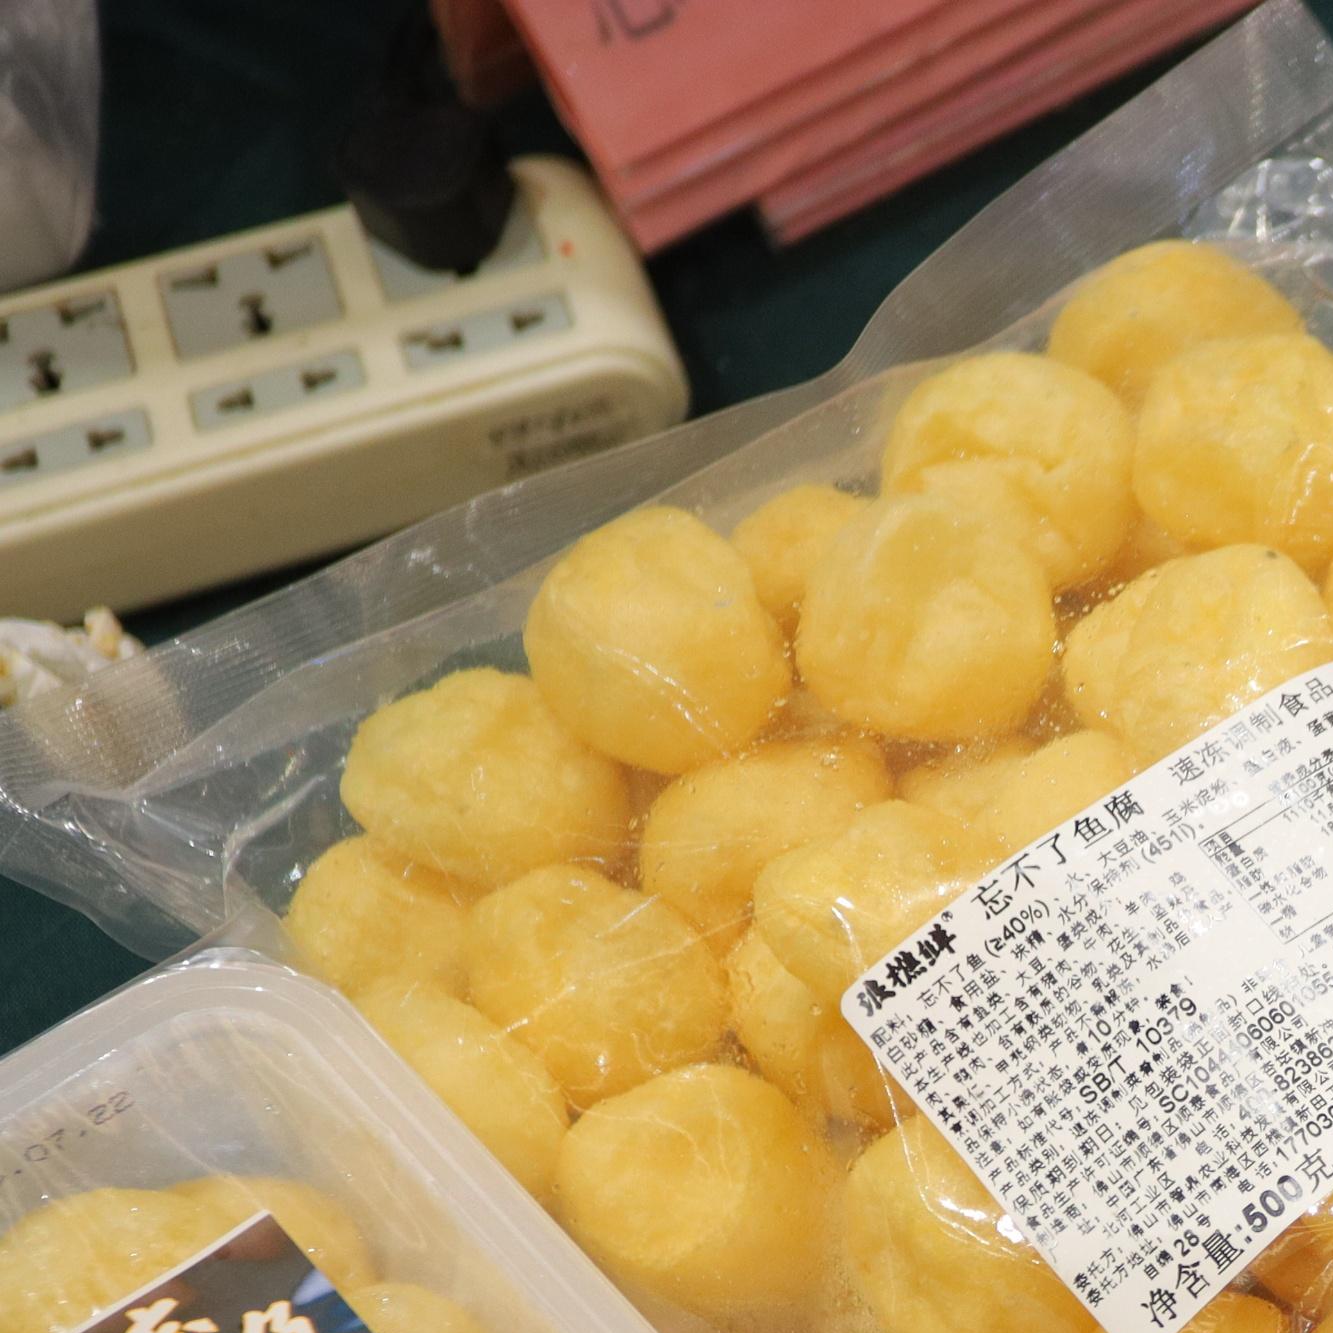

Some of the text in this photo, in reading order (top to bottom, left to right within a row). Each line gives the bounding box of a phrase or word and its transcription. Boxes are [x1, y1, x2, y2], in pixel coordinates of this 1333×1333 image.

[965, 786, 1148, 921] 忘不了鱼腐
[1132, 994, 1200, 1055] 10379
[1101, 1171, 1176, 1239] 北河工业区
